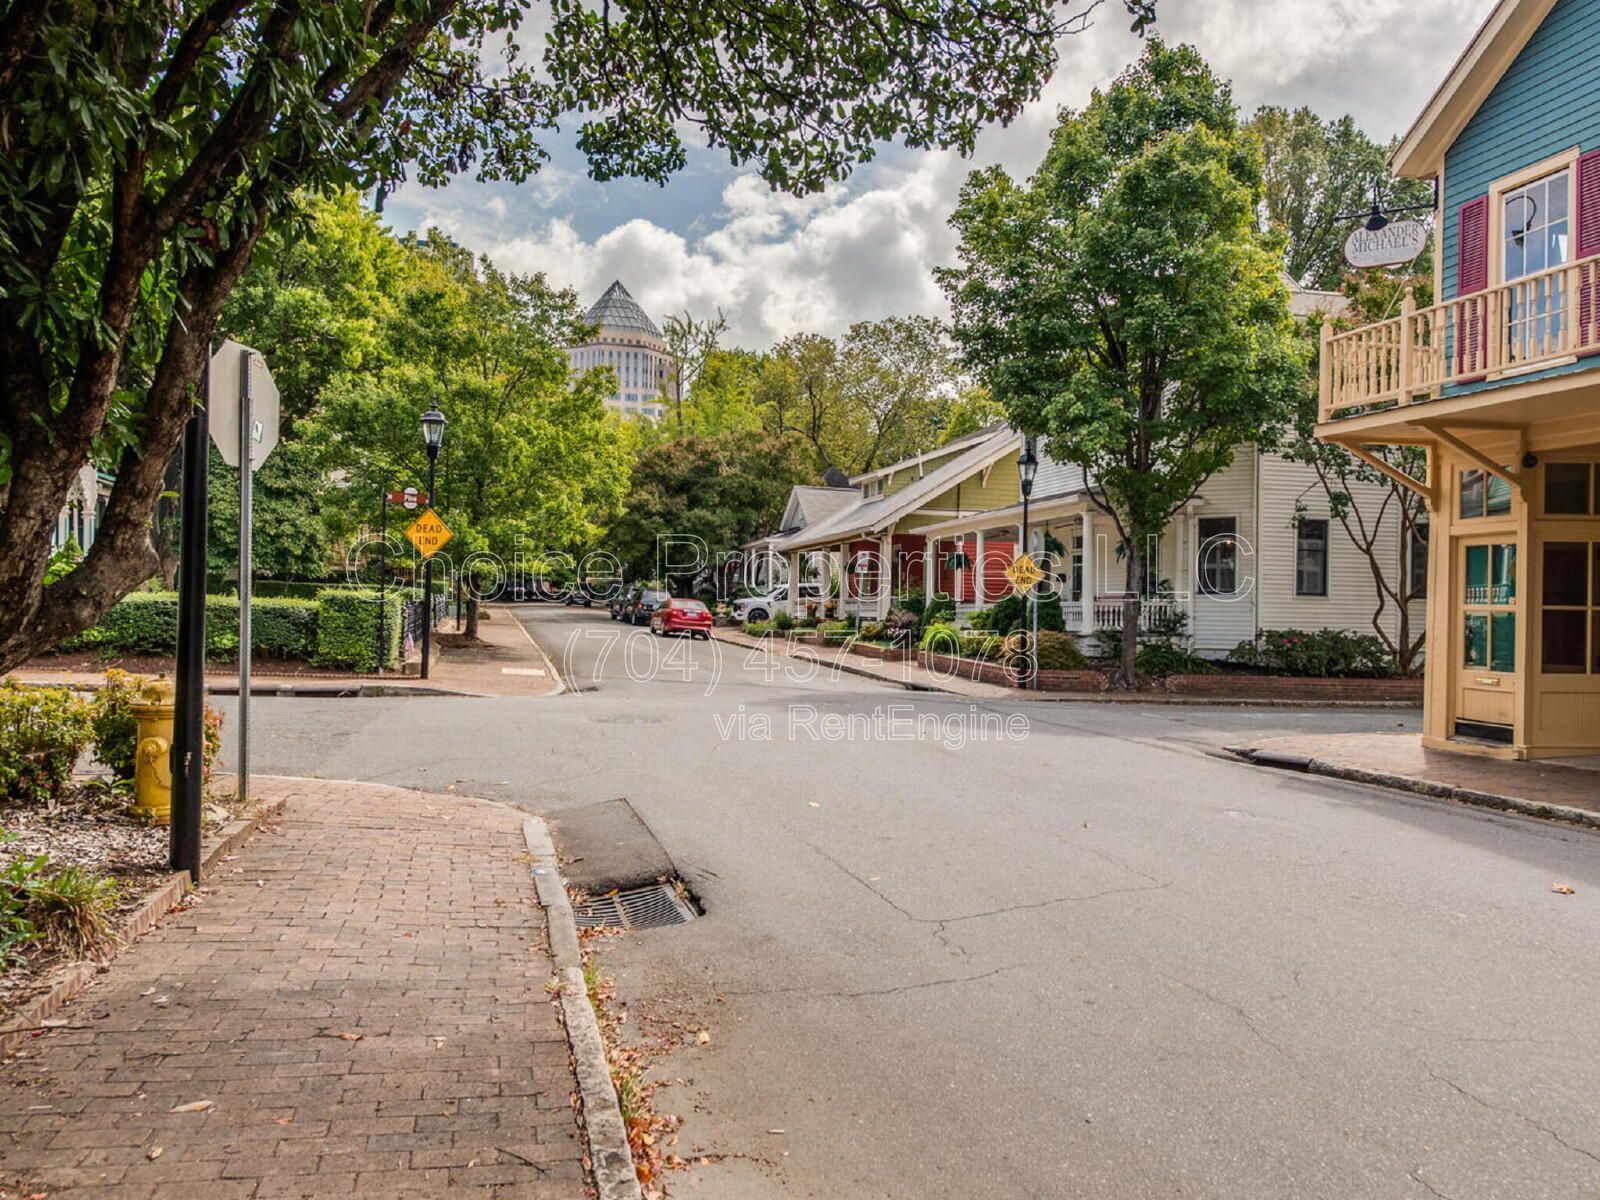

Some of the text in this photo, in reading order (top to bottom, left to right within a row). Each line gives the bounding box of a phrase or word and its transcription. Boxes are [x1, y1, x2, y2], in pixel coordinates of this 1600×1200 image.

[1353, 223, 1420, 243] ALEXANDER
[416, 524, 442, 533] DEAD
[419, 536, 438, 545] END
